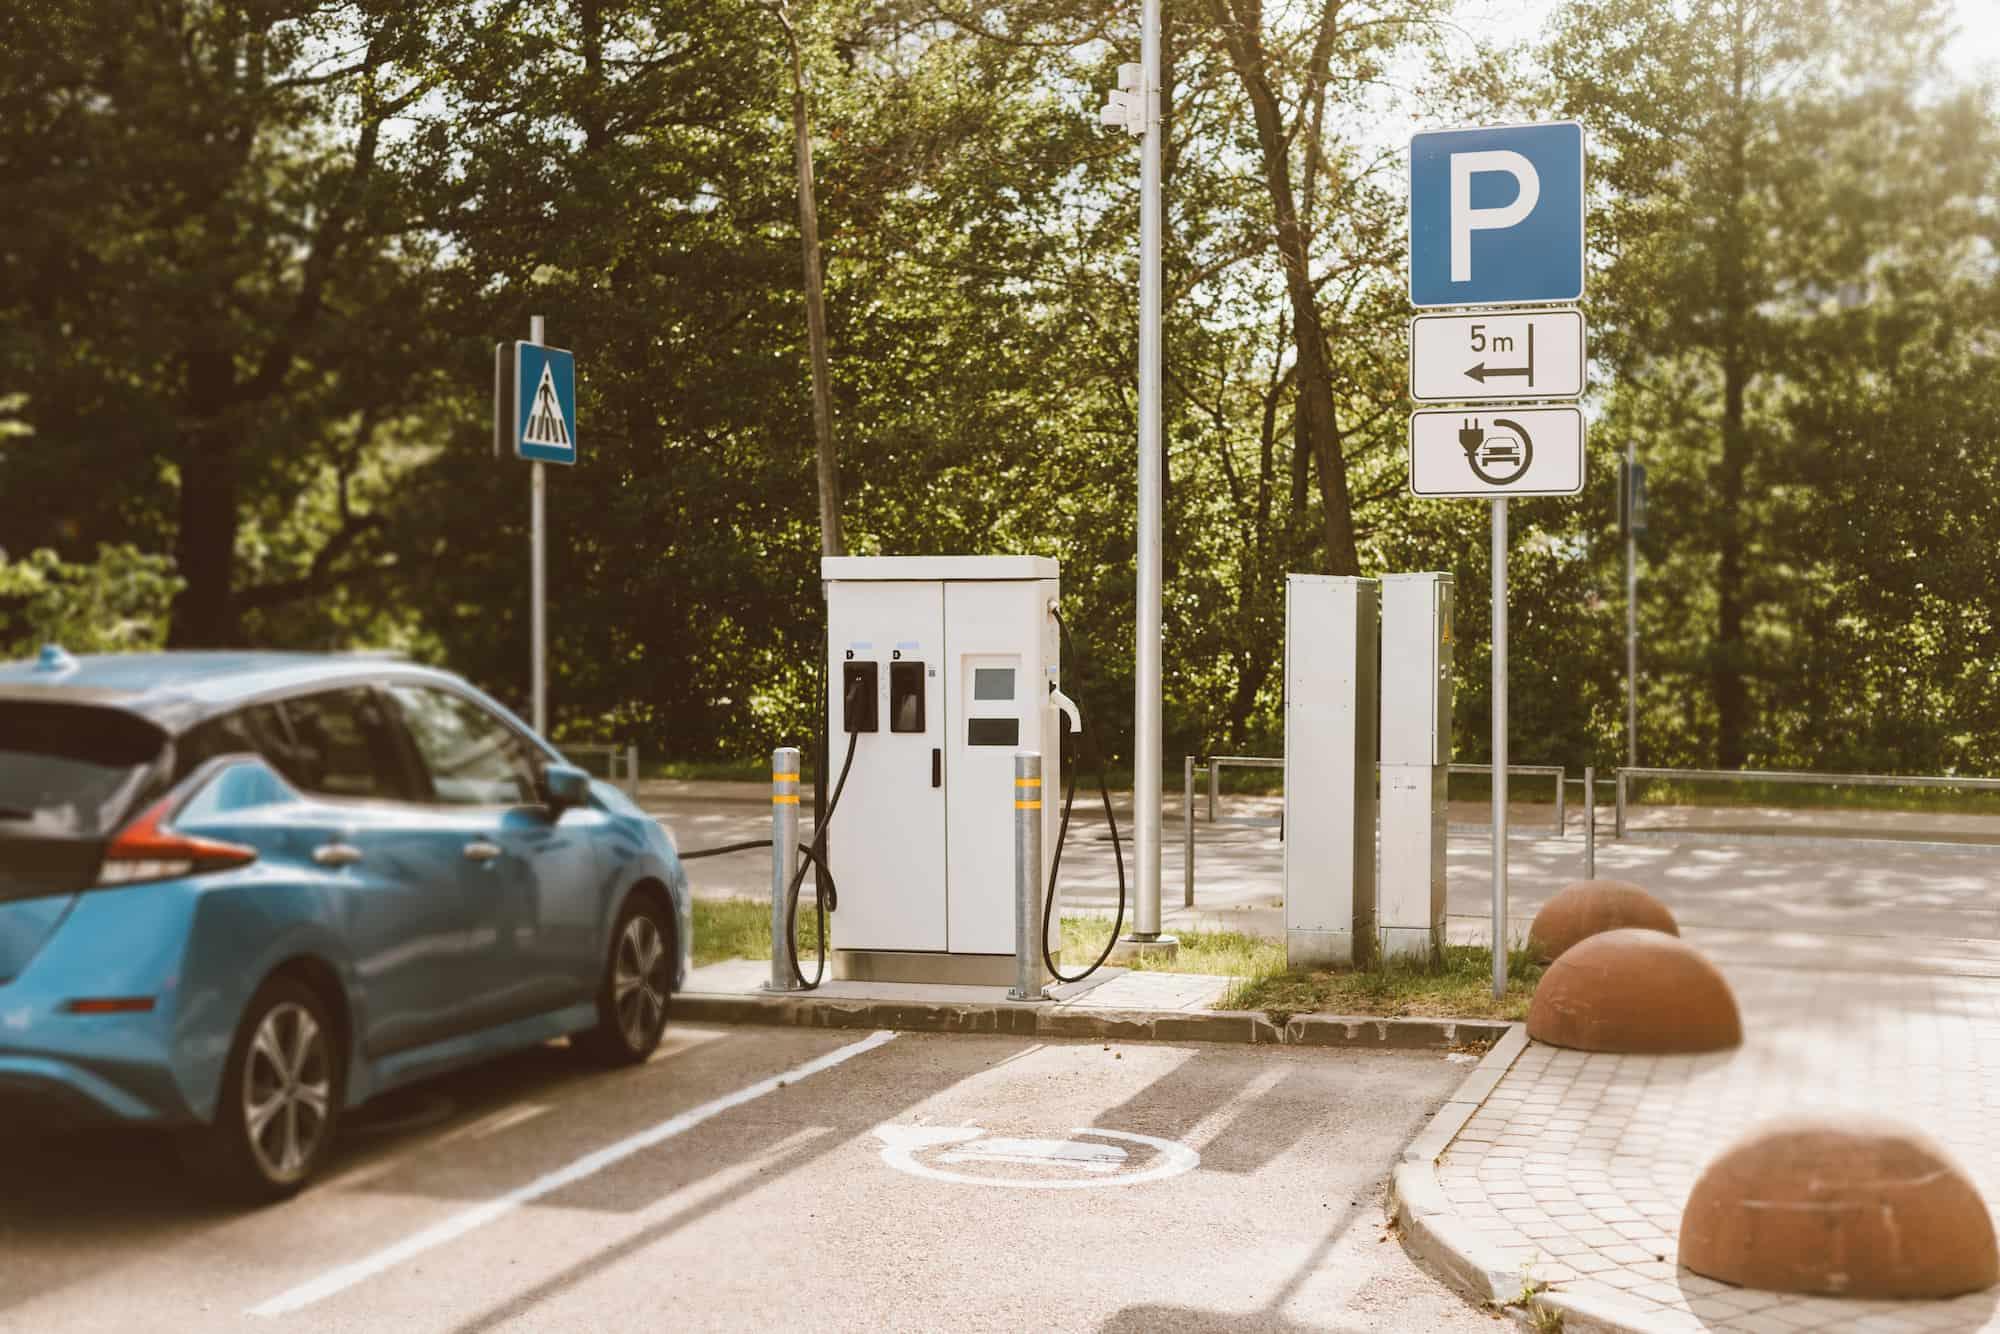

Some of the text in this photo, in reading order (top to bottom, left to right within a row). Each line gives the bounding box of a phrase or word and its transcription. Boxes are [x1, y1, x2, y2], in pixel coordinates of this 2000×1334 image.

[1450, 149, 1541, 283] P
[1470, 324, 1514, 353] 5 m
